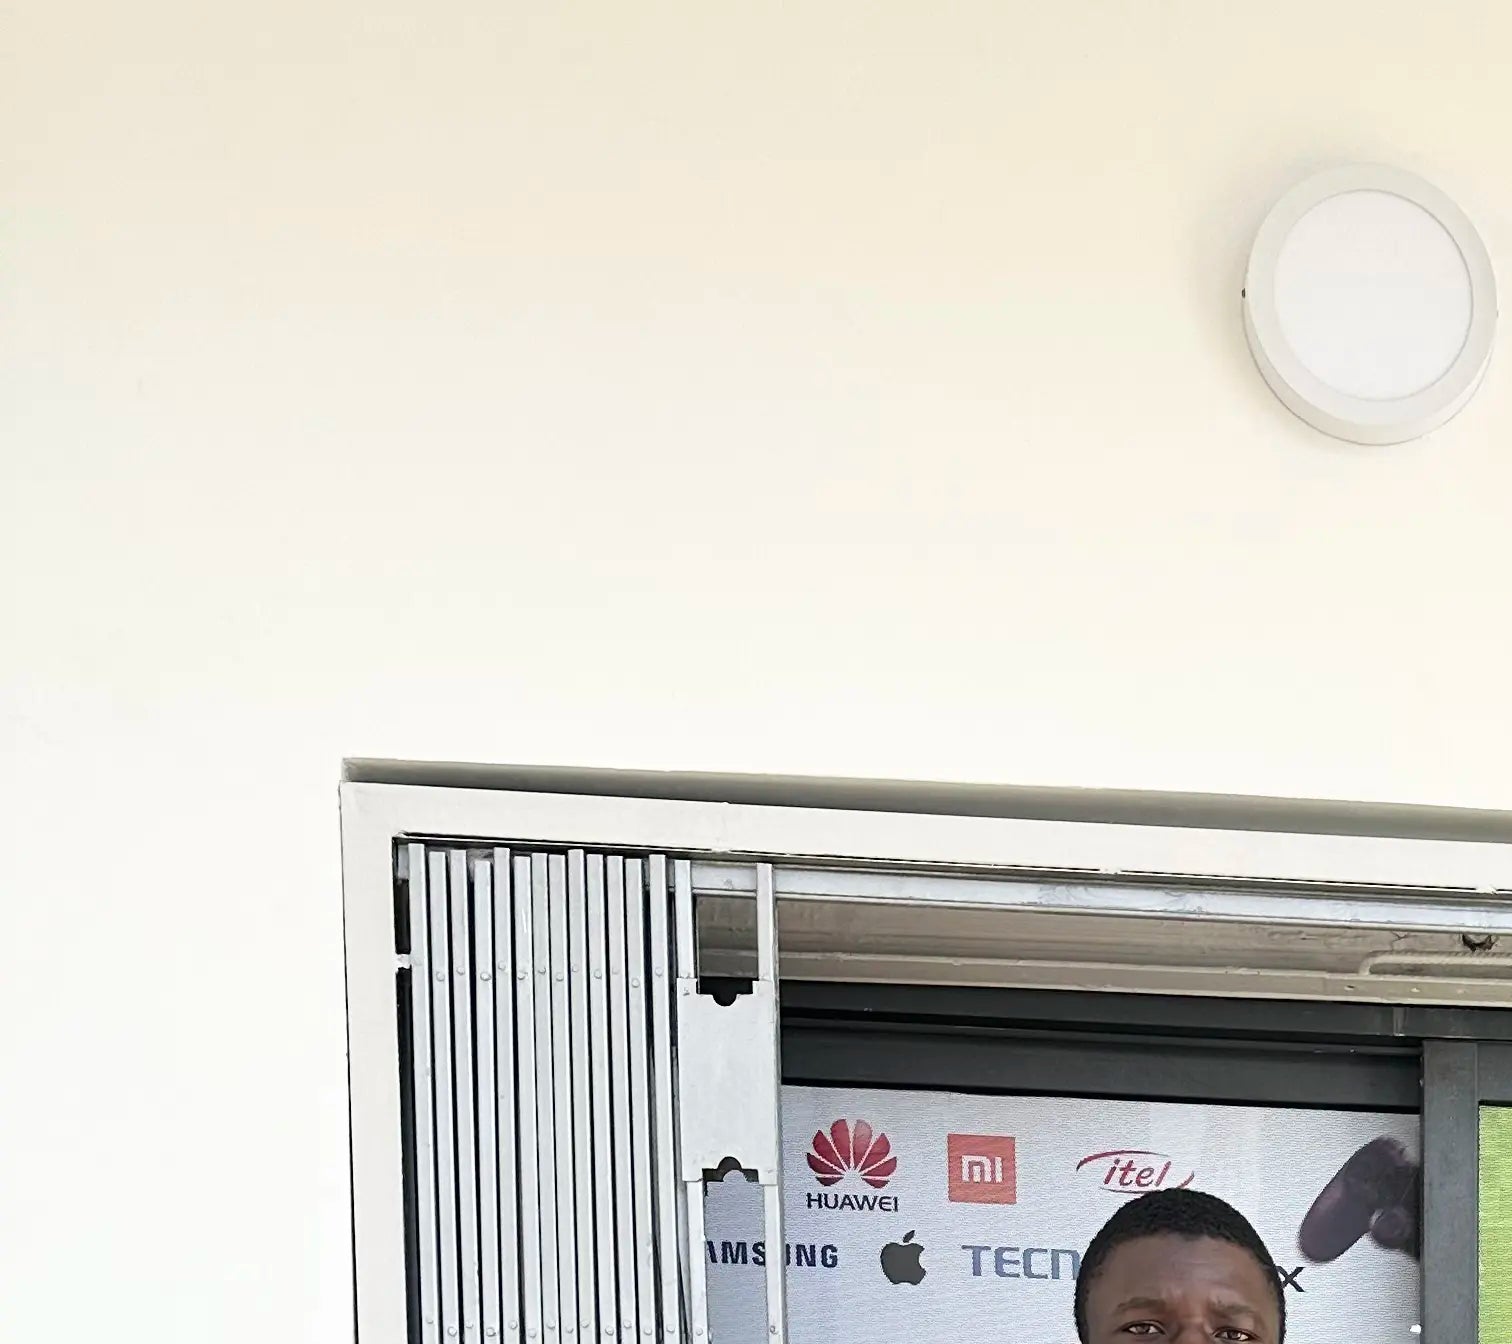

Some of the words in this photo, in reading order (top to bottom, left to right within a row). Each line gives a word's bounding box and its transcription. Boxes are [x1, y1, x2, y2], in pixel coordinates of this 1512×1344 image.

[1103, 1159, 1172, 1188] itel
[806, 1193, 898, 1212] HUAWEI
[706, 1240, 838, 1268] AMSNG
[961, 1244, 1080, 1280] TECN
